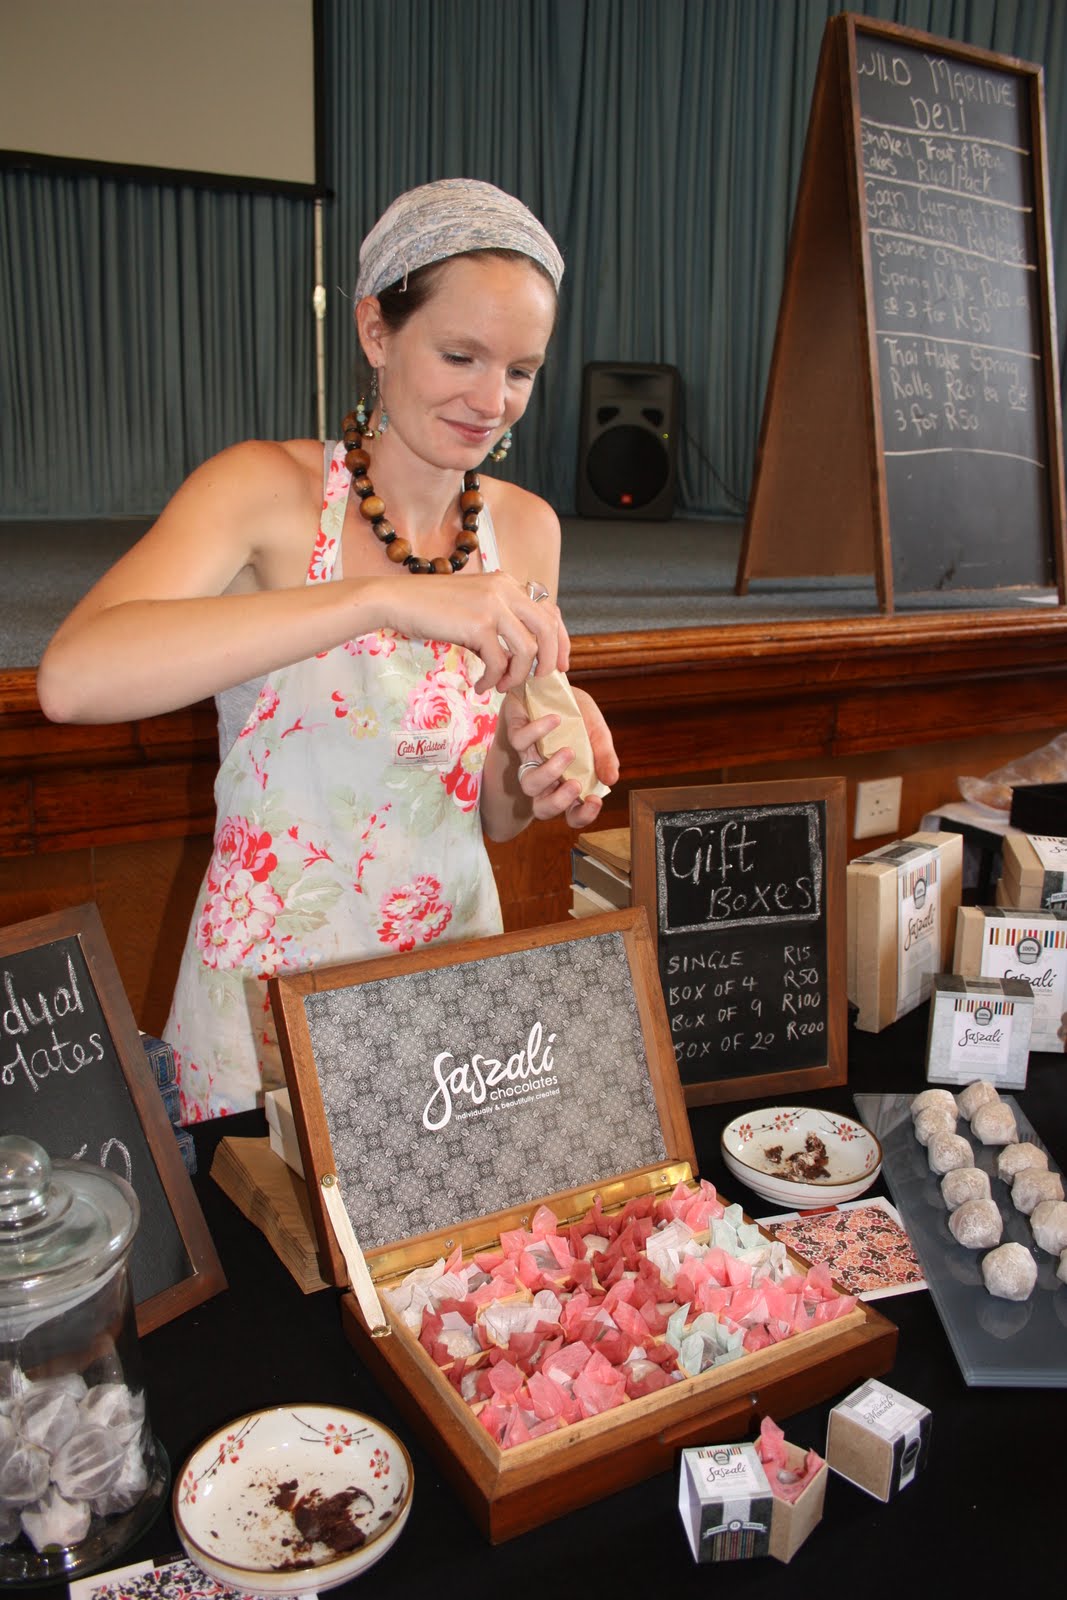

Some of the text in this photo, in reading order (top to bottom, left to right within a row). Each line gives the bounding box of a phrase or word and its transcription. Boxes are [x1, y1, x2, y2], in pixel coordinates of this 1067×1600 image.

[924, 54, 1016, 107] MARINE
[884, 338, 918, 367] Thai
[889, 367, 933, 400] Rolls
[896, 410, 907, 432] 3
[911, 403, 939, 437] for
[397, 740, 415, 757] Cath
[671, 820, 757, 886] Gift
[667, 945, 811, 975] SINGLE R15
[669, 968, 819, 1006] BOX OF 4 R50
[718, 1006, 738, 1023] OF
[751, 999, 762, 1017] 9
[782, 992, 821, 1015] R100
[674, 1021, 824, 1063] BOX OF 20 R200
[423, 1021, 557, 1131] Saszali
[490, 1075, 558, 1101] chocolates
[455, 1105, 494, 1121] individually
[501, 1094, 535, 1109] beautifully
[535, 1088, 560, 1100] created
